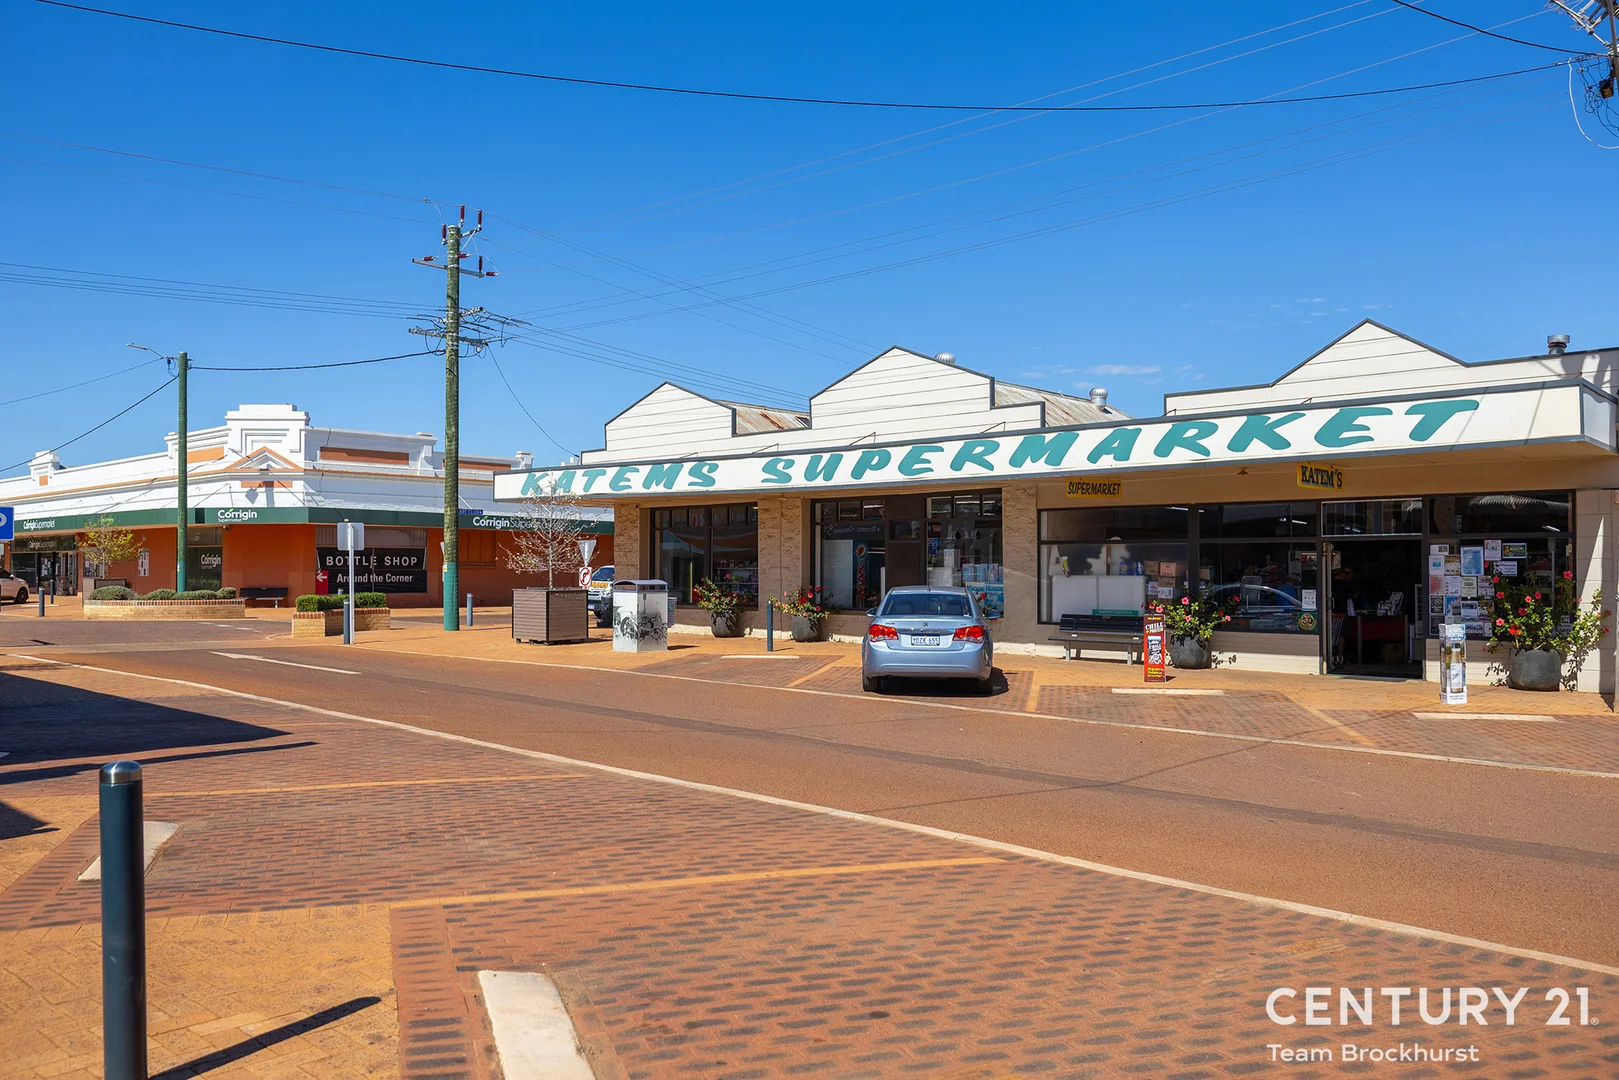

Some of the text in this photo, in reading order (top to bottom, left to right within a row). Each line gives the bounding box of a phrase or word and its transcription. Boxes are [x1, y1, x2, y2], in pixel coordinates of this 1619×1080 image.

[521, 399, 1479, 495] KATEMS SUPERMARKET
[1301, 465, 1343, 488] KATEM'S
[1067, 481, 1121, 496] SUPERMARKET
[217, 508, 257, 521] Corrigin
[472, 516, 510, 529] Corrigin
[200, 554, 222, 568] Corrigin
[326, 556, 417, 566] BOTTLE SHOP
[370, 574, 383, 583] the
[385, 574, 413, 583] Corner
